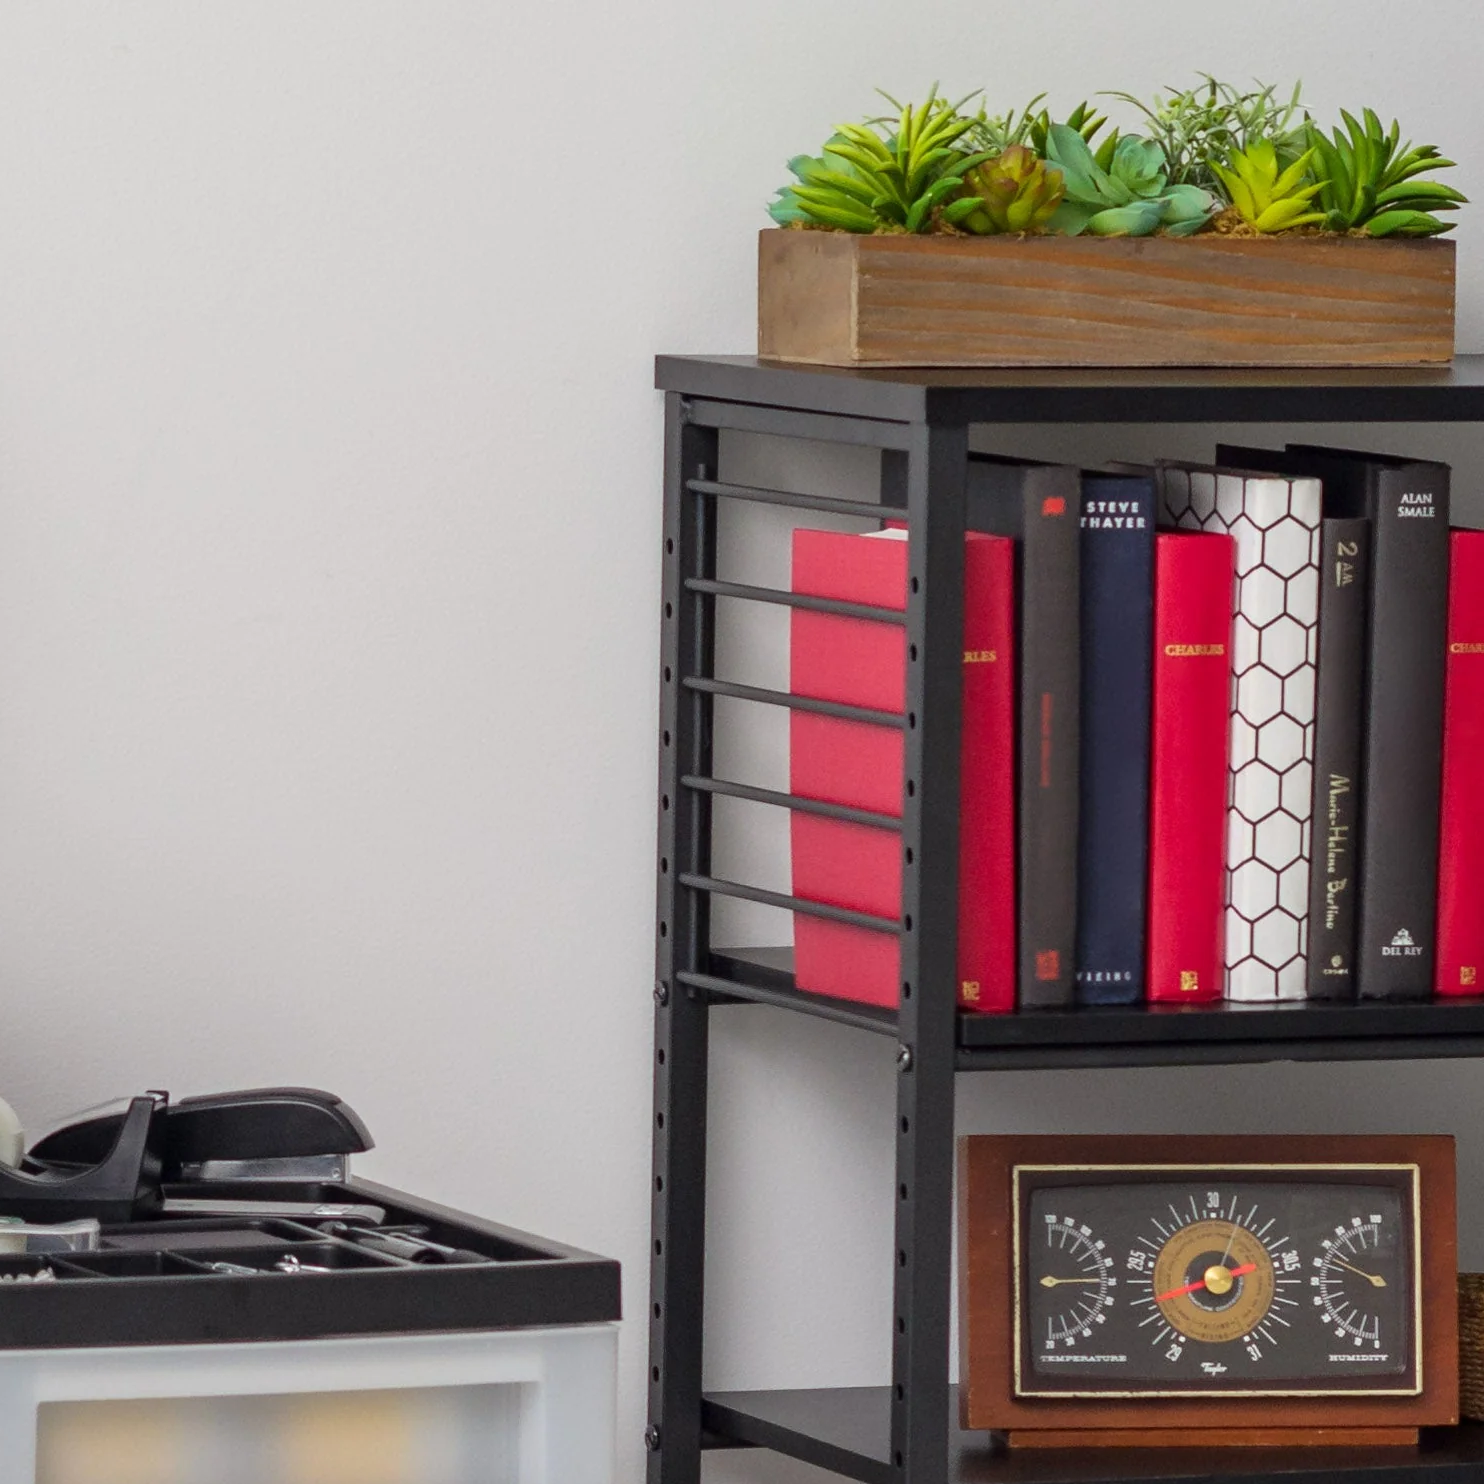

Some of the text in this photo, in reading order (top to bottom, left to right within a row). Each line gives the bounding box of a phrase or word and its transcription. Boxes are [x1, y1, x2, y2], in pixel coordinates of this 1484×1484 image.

[1400, 492, 1433, 504] ALAN
[1086, 501, 1139, 513] STEVE
[1397, 506, 1435, 518] SMALE
[1079, 517, 1146, 529] THAYER
[1337, 541, 1358, 557] 2
[1164, 643, 1225, 657] CHARLES
[1381, 946, 1423, 956] DEL REY
[1206, 1192, 1219, 1208] 30
[1040, 1355, 1127, 1363] TEMPERATURE
[1165, 1344, 1183, 1362] 29
[1329, 1354, 1389, 1362] HUMIDITY
